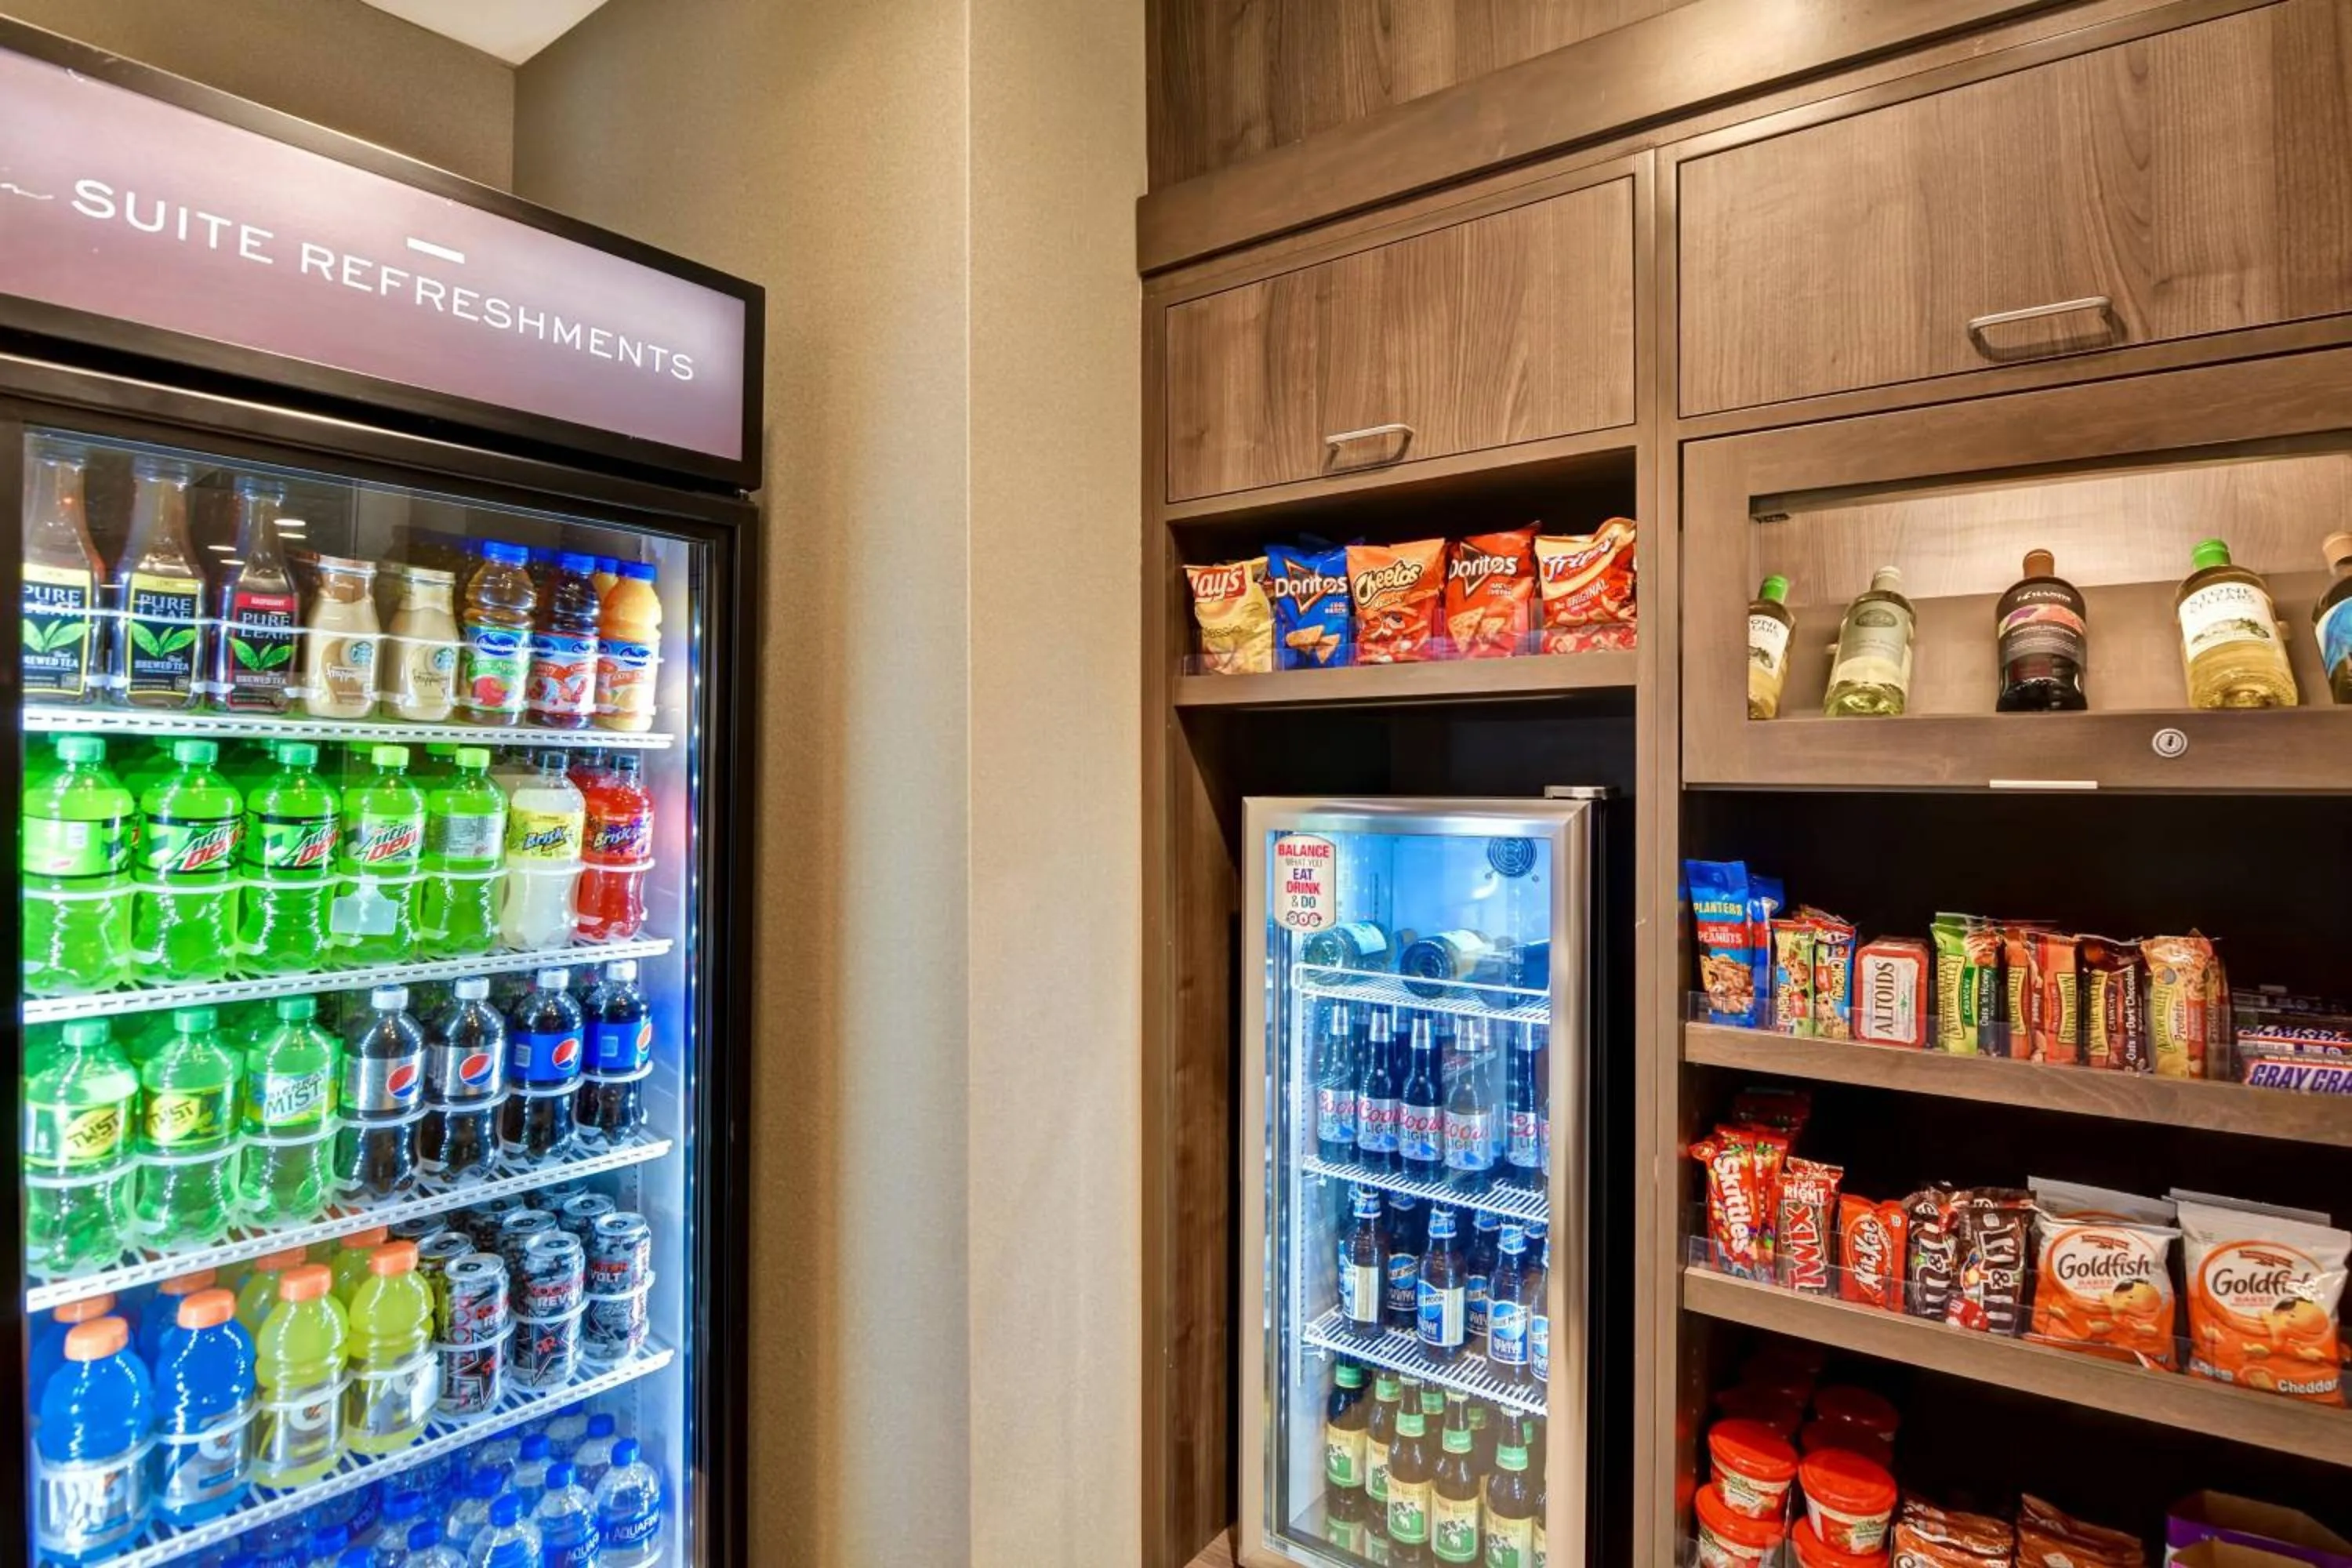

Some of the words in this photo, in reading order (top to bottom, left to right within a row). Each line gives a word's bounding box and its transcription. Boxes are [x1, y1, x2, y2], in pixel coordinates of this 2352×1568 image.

[72, 179, 274, 266] SUITE
[299, 241, 696, 383] REFRESHMENTS
[1449, 554, 1519, 579] Doritos
[1275, 575, 1348, 597] Doritos
[1354, 560, 1424, 605] Cheetos
[139, 593, 192, 611] PURE
[241, 612, 291, 628] PURE
[24, 655, 59, 666] REWED
[1277, 844, 1330, 858] BALANCE
[1292, 867, 1314, 880] EAT
[1286, 880, 1320, 895] DRINK
[1301, 895, 1316, 909] DO
[1693, 902, 1743, 916] PLANTERS
[1697, 931, 1743, 944] PEANUTS
[1875, 962, 1896, 1034] ALTOIDS
[265, 1079, 322, 1120] MIST
[1784, 1185, 1827, 1204] RIGHT
[1713, 1156, 1752, 1254] Skittles
[1785, 1204, 1828, 1292] TWIX
[2057, 1252, 2151, 1280] Goldfish
[2212, 1268, 2315, 1296] Goldfi
[2278, 1378, 2339, 1394] Cheddar
